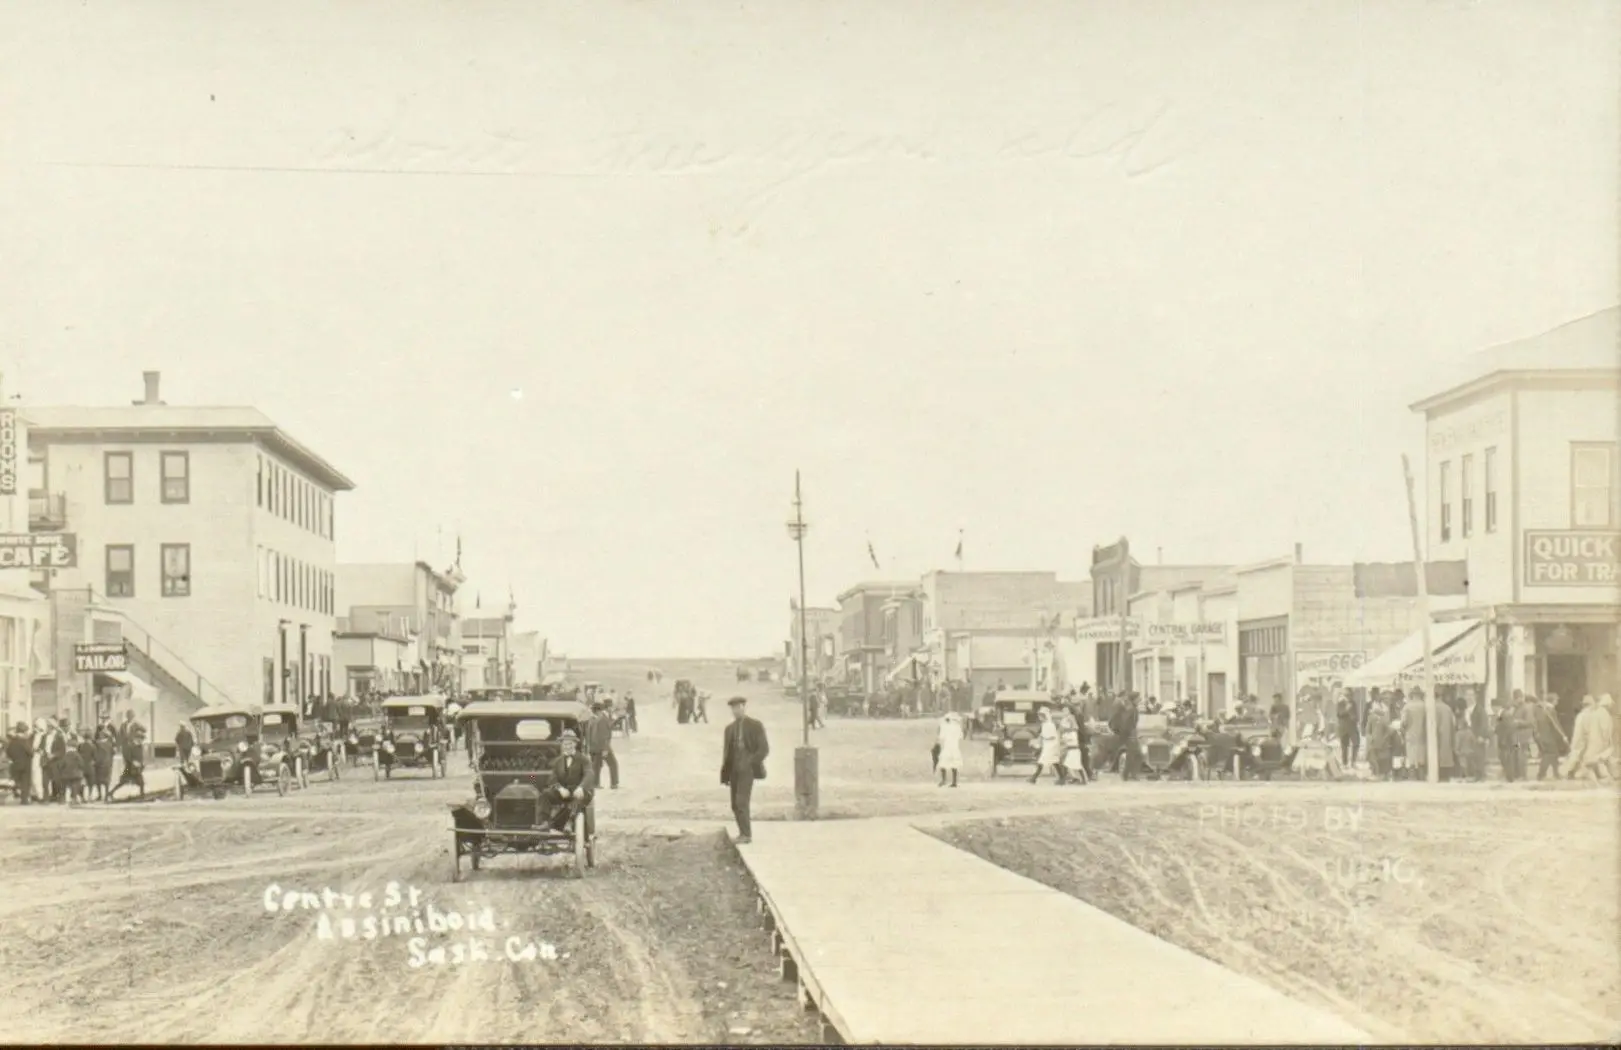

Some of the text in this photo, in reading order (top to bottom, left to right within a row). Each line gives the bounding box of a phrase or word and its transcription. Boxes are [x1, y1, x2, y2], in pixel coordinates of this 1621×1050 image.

[2, 411, 14, 489] ROOMS
[1534, 537, 1615, 560] QUICK
[1535, 562, 1579, 581] FOR
[77, 655, 126, 669] TAILOR
